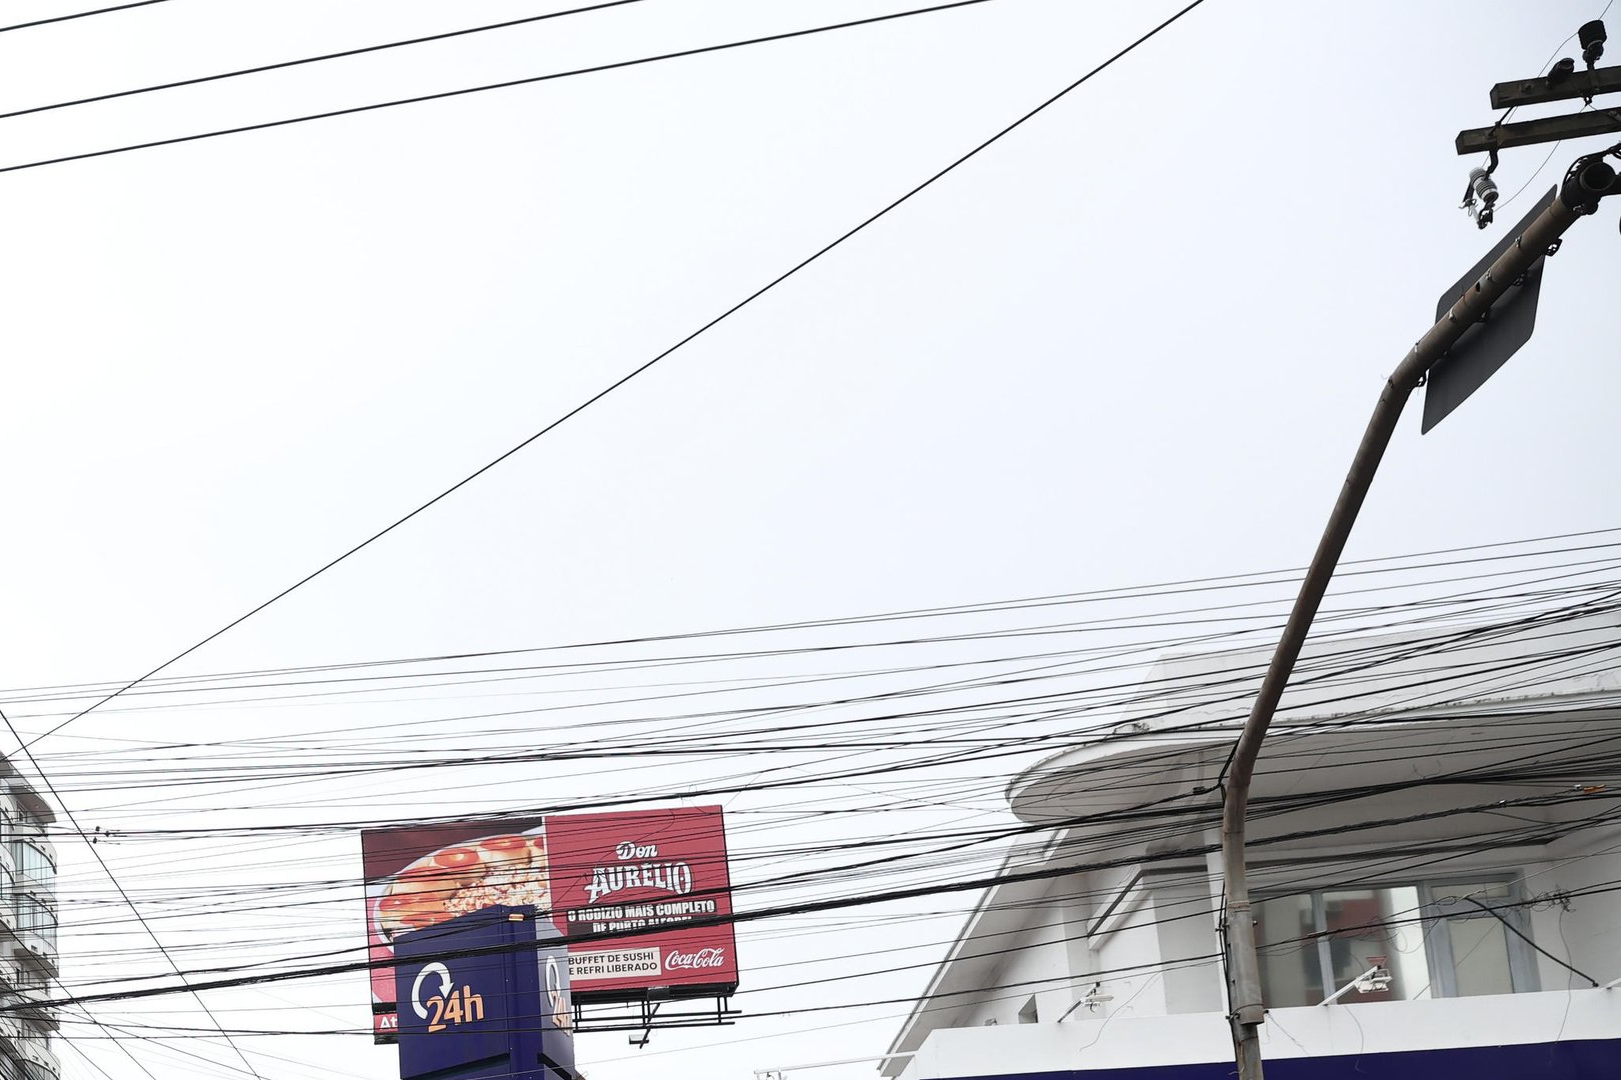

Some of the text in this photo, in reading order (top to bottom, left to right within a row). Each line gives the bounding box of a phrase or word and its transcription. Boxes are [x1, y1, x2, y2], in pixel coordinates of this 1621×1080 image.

[616, 841, 658, 860] Don
[625, 906, 654, 918] MAIS
[656, 900, 715, 915] COMPLETO
[568, 952, 654, 966] BUFFET DE SUSHI
[569, 962, 658, 975] E REFRI LIBERADO
[426, 985, 484, 1033] 24h
